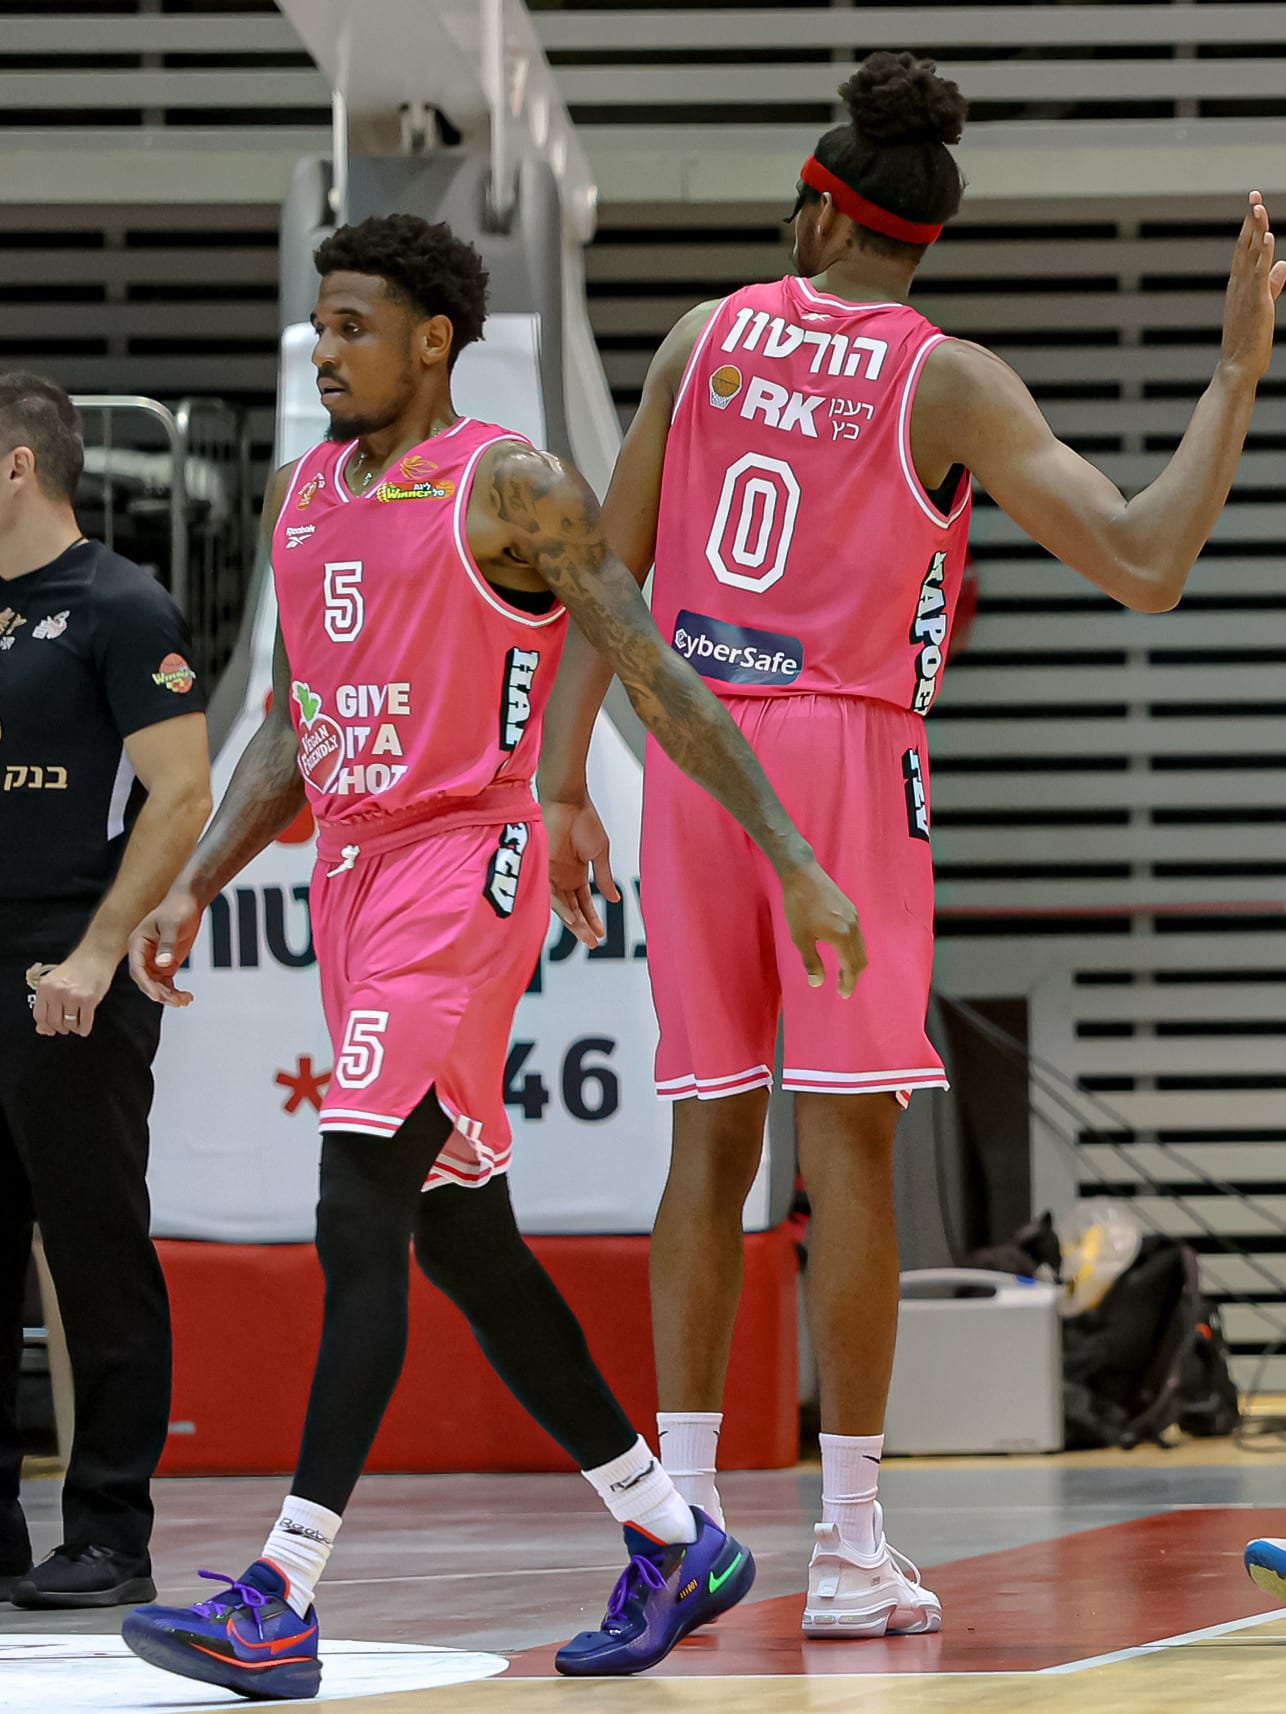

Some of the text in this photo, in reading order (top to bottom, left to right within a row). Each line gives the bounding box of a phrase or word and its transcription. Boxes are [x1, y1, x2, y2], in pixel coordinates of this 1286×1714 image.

[720, 307, 888, 381] הורטון
[740, 375, 827, 438] RK
[832, 420, 861, 441] כץ
[386, 487, 432, 499] Winner
[286, 525, 316, 536] Reebok
[705, 451, 801, 593] 0
[324, 561, 365, 643] 5
[336, 682, 411, 718] GIVE
[302, 724, 330, 755] VEGAN
[346, 723, 403, 759] IT A
[4, 765, 68, 791] בנק
[329, 763, 408, 795] HOT
[335, 1010, 389, 1089] 5
[280, 1517, 332, 1545] Reebo
